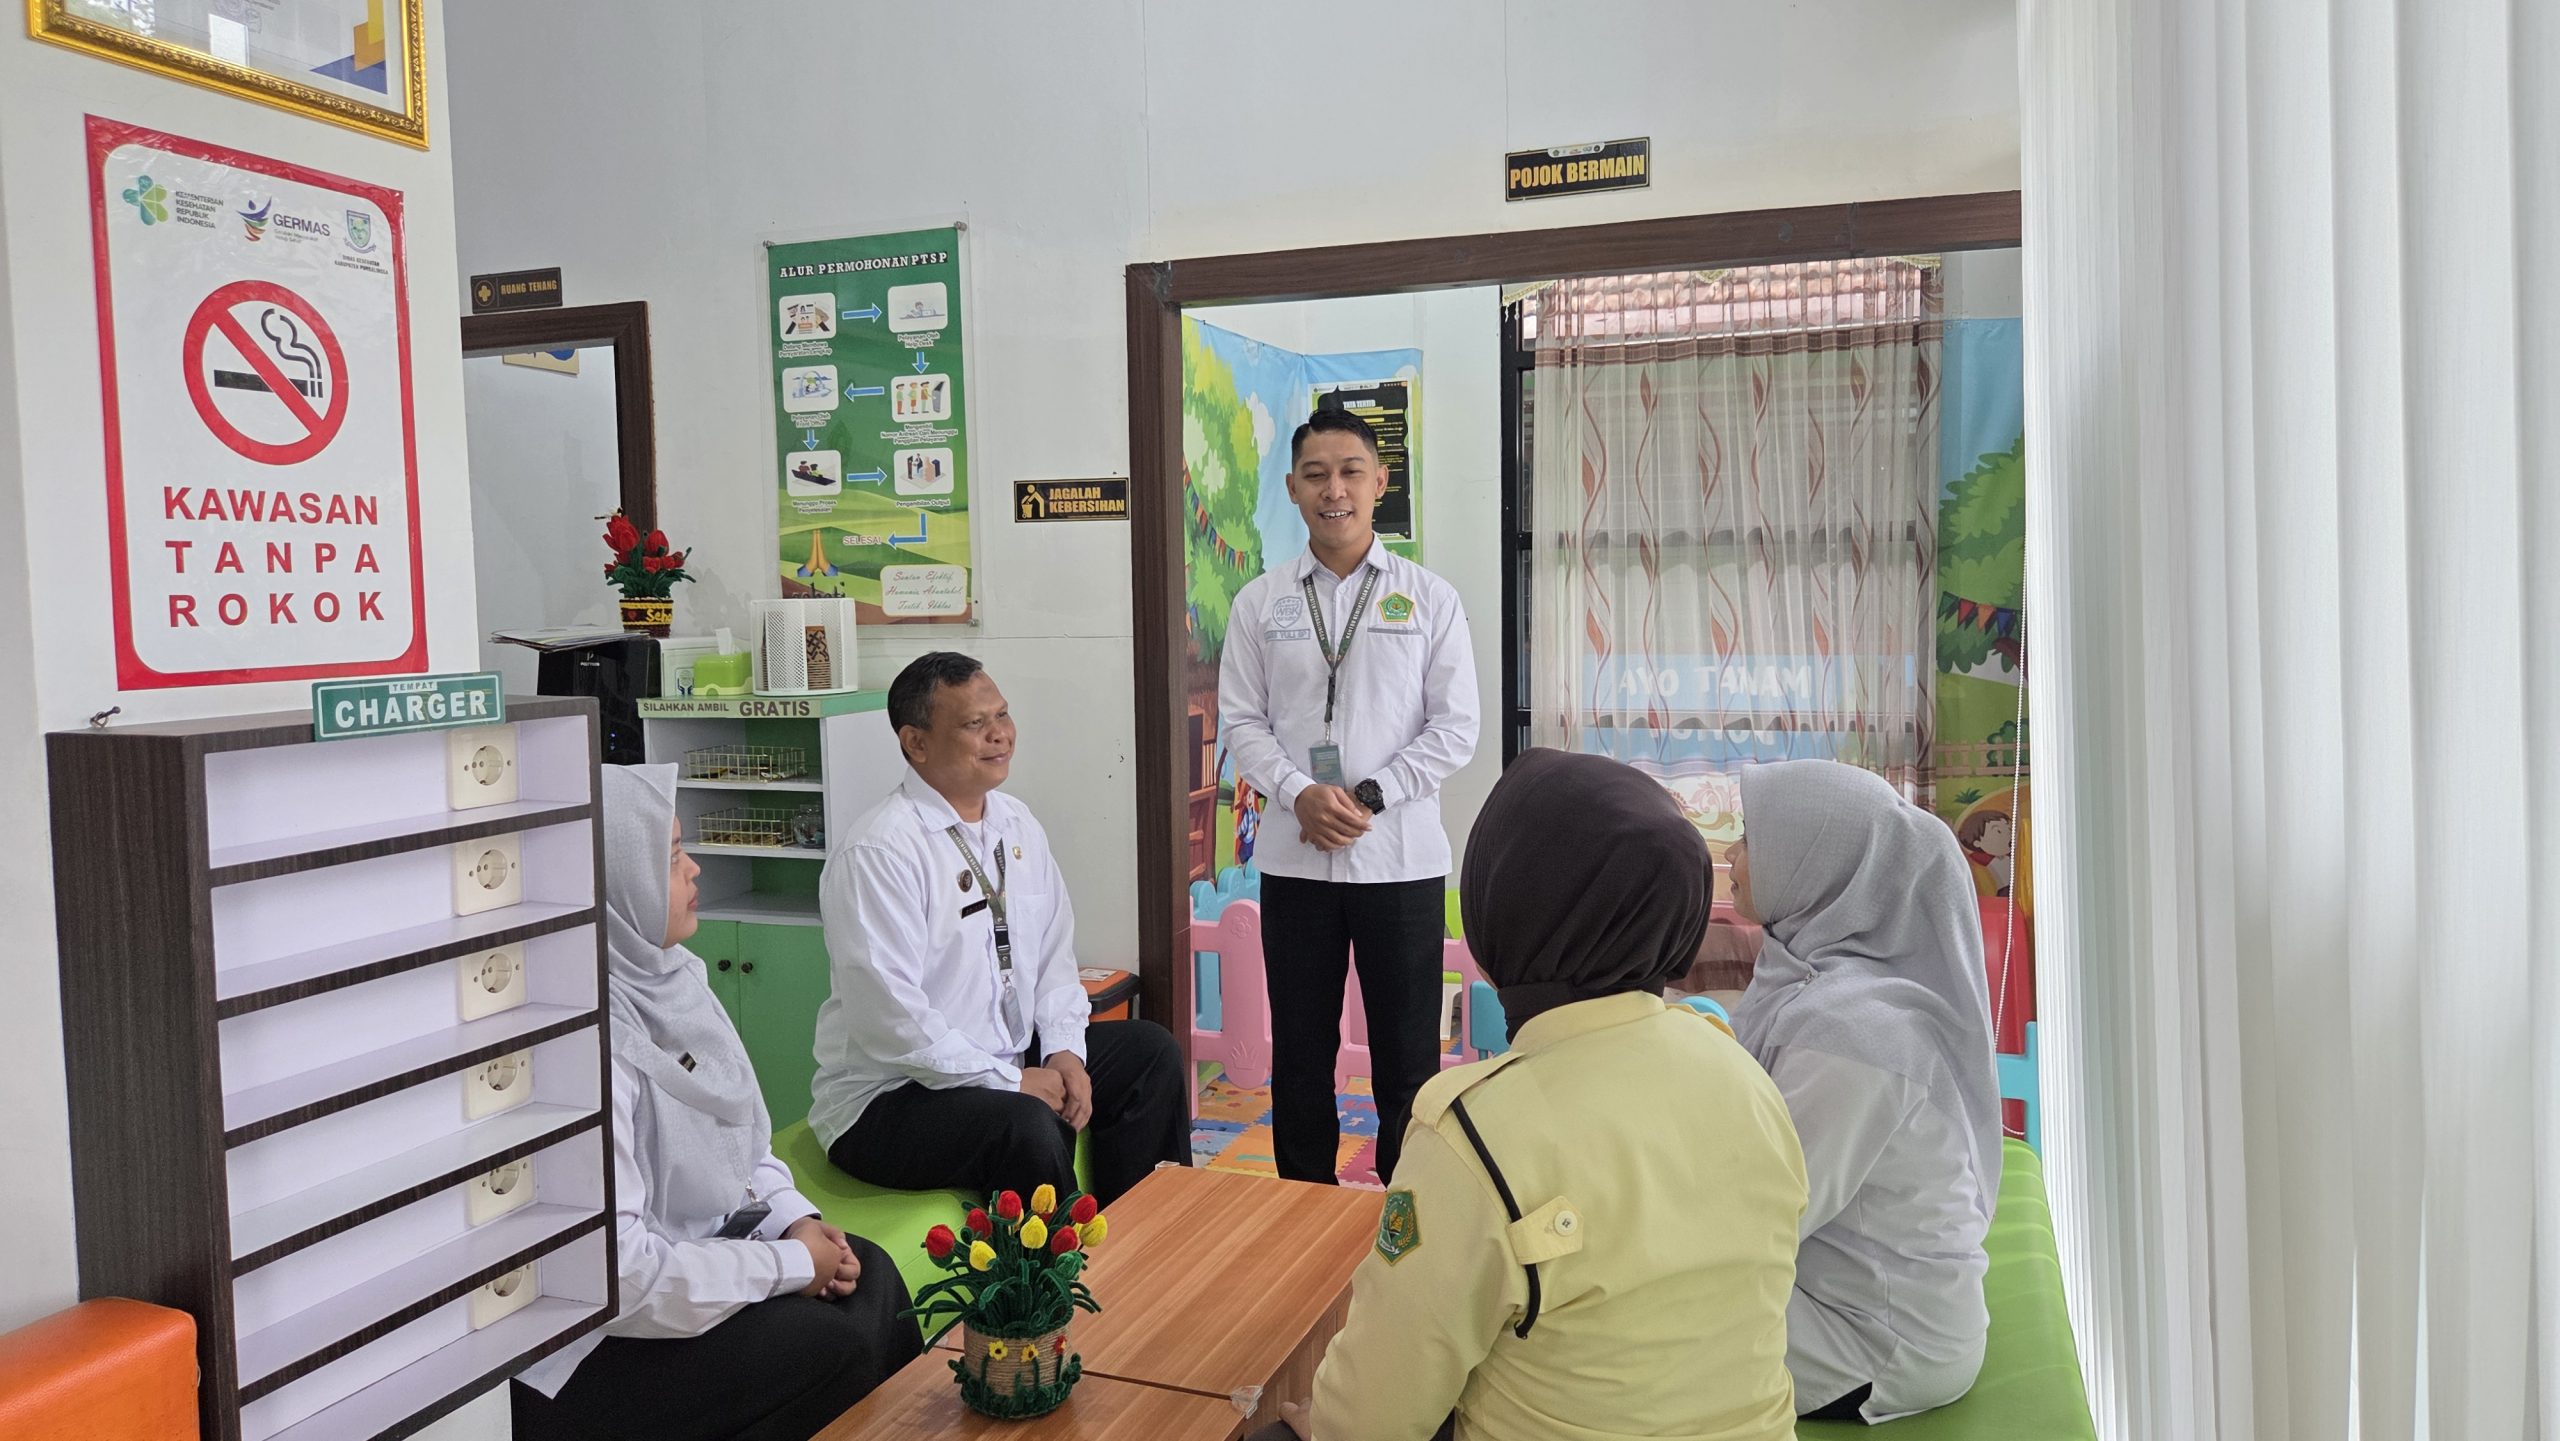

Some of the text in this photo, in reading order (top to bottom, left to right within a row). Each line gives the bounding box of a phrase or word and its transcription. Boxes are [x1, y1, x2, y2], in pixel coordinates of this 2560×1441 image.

[1510, 154, 1645, 189] POJOK BERMAIN
[175, 199, 216, 214] KESEHATAN
[177, 216, 216, 229] INDONESIA
[273, 213, 330, 237] GERMAS
[780, 265, 814, 278] ALUR
[818, 255, 909, 275] PERMOHONAN
[501, 280, 557, 295] RUANG TENANG
[1049, 487, 1101, 500] JAGALAH
[164, 486, 378, 525] KAWASAN
[1049, 499, 1125, 513] KEBERSIHAN
[843, 536, 881, 545] SELESAI
[165, 540, 380, 574] TANPA
[168, 591, 385, 628] ROKOK
[392, 682, 434, 691] TEMPAT
[1619, 666, 1680, 698] AYO
[335, 690, 487, 728] CHARGER
[643, 701, 810, 717] SILAHKAN AMBIL GRATIS
